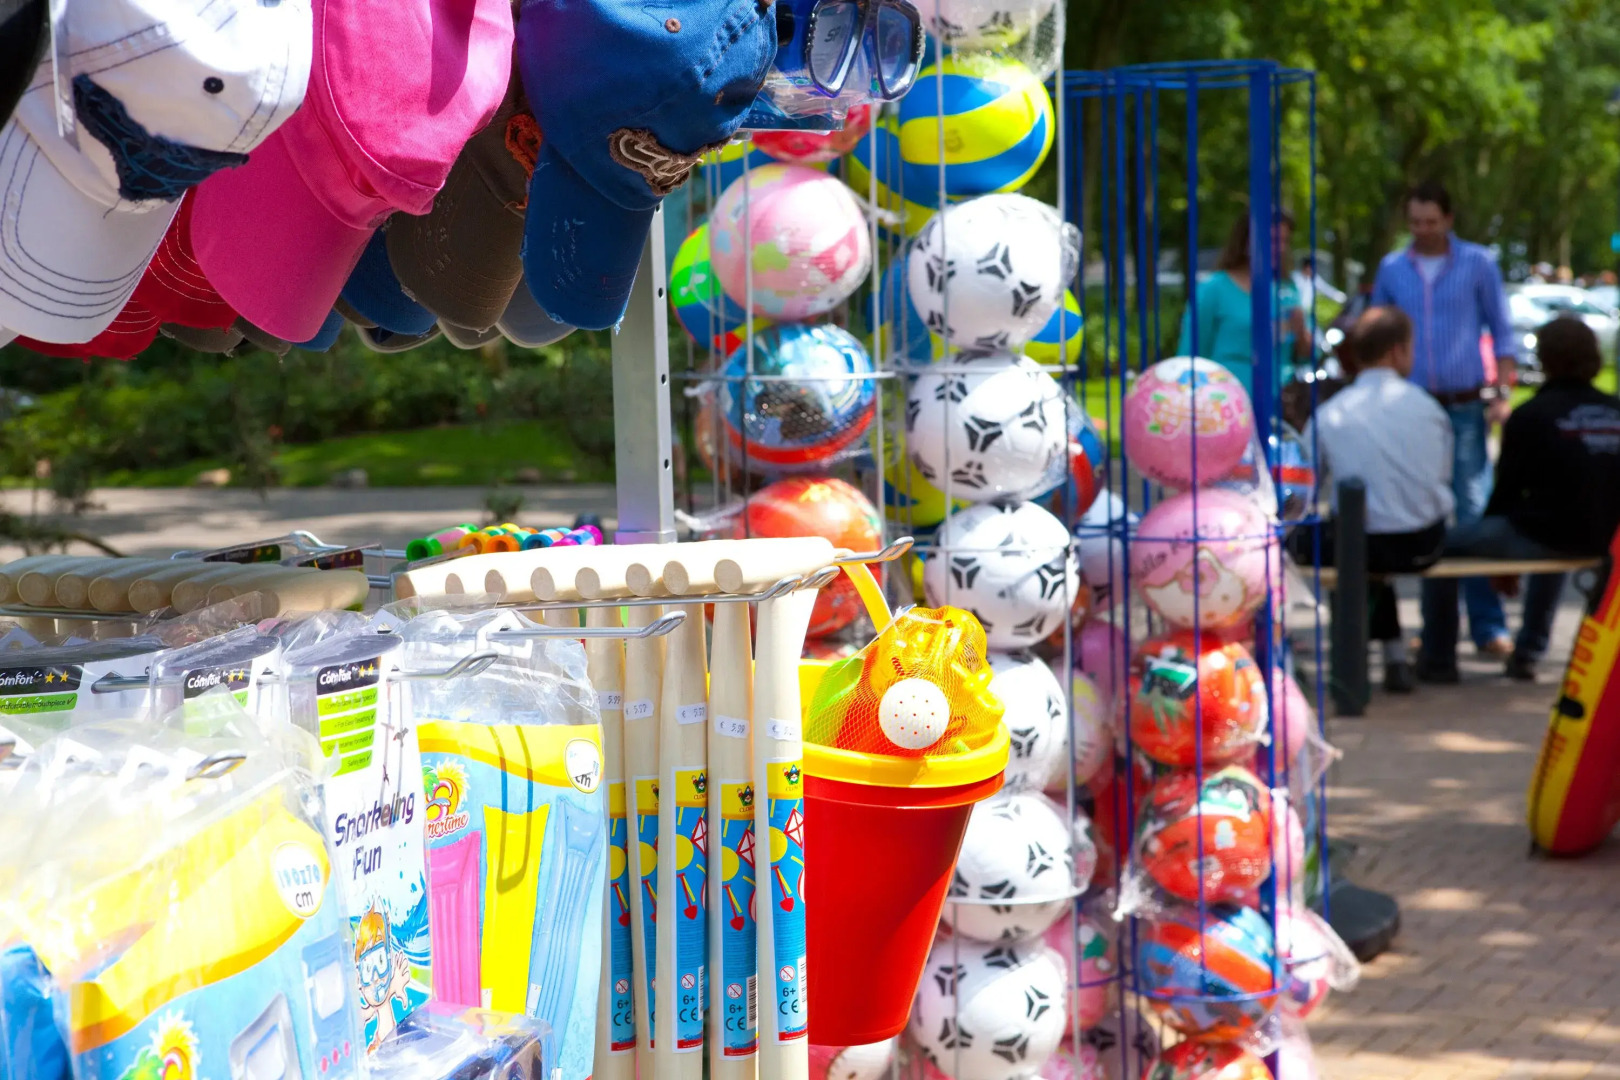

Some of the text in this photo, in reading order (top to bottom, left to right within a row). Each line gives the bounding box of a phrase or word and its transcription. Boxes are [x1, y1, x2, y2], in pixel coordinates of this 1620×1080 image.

[0, 674, 34, 686] omfort
[334, 792, 415, 847] Snorkeling
[352, 845, 382, 880] Fun
[295, 891, 314, 908] cm
[782, 987, 796, 998] 6+
[617, 999, 630, 1009] 6+
[682, 994, 696, 1005] 6+
[728, 1003, 743, 1014] 6+
